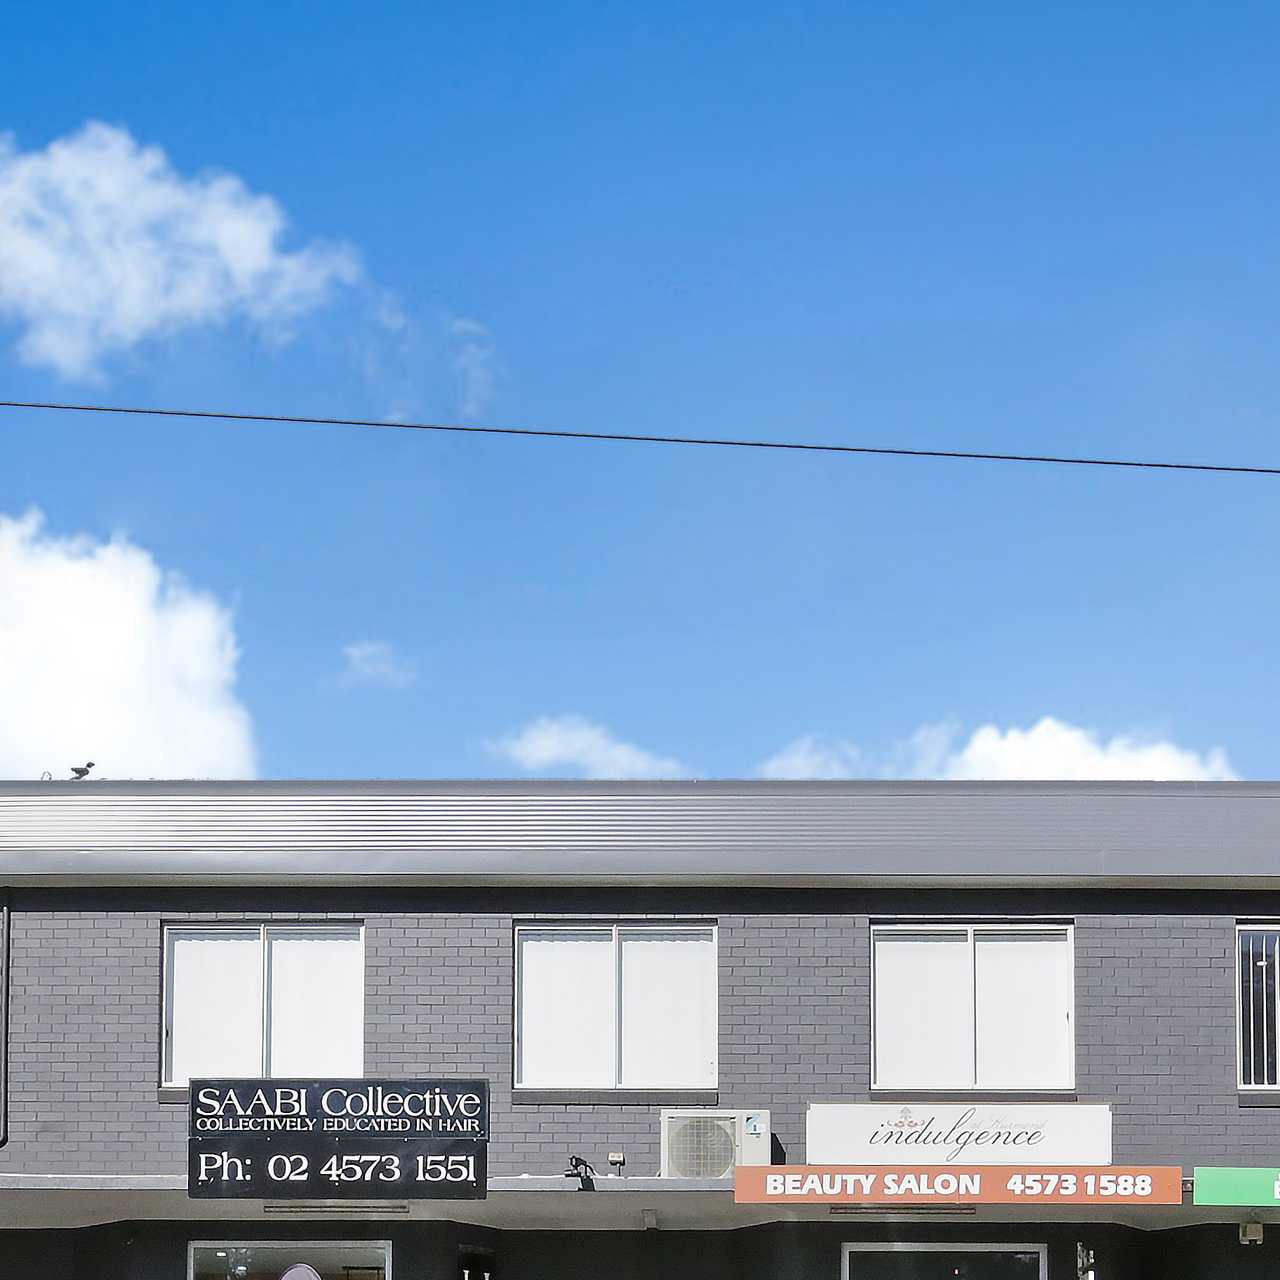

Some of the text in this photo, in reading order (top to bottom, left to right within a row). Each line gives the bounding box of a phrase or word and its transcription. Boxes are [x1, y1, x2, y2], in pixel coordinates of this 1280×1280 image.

[196, 1086, 481, 1117] SAABI Collective
[196, 1118, 317, 1131] COLLECTIVELY
[322, 1118, 411, 1131] EDUCATED
[416, 1118, 433, 1131] IN
[869, 1107, 1046, 1162] indulgence
[199, 1152, 476, 1182] Ph: 02 4573 1551
[766, 1174, 1153, 1196] BEAUTY SALON 4573 1588
